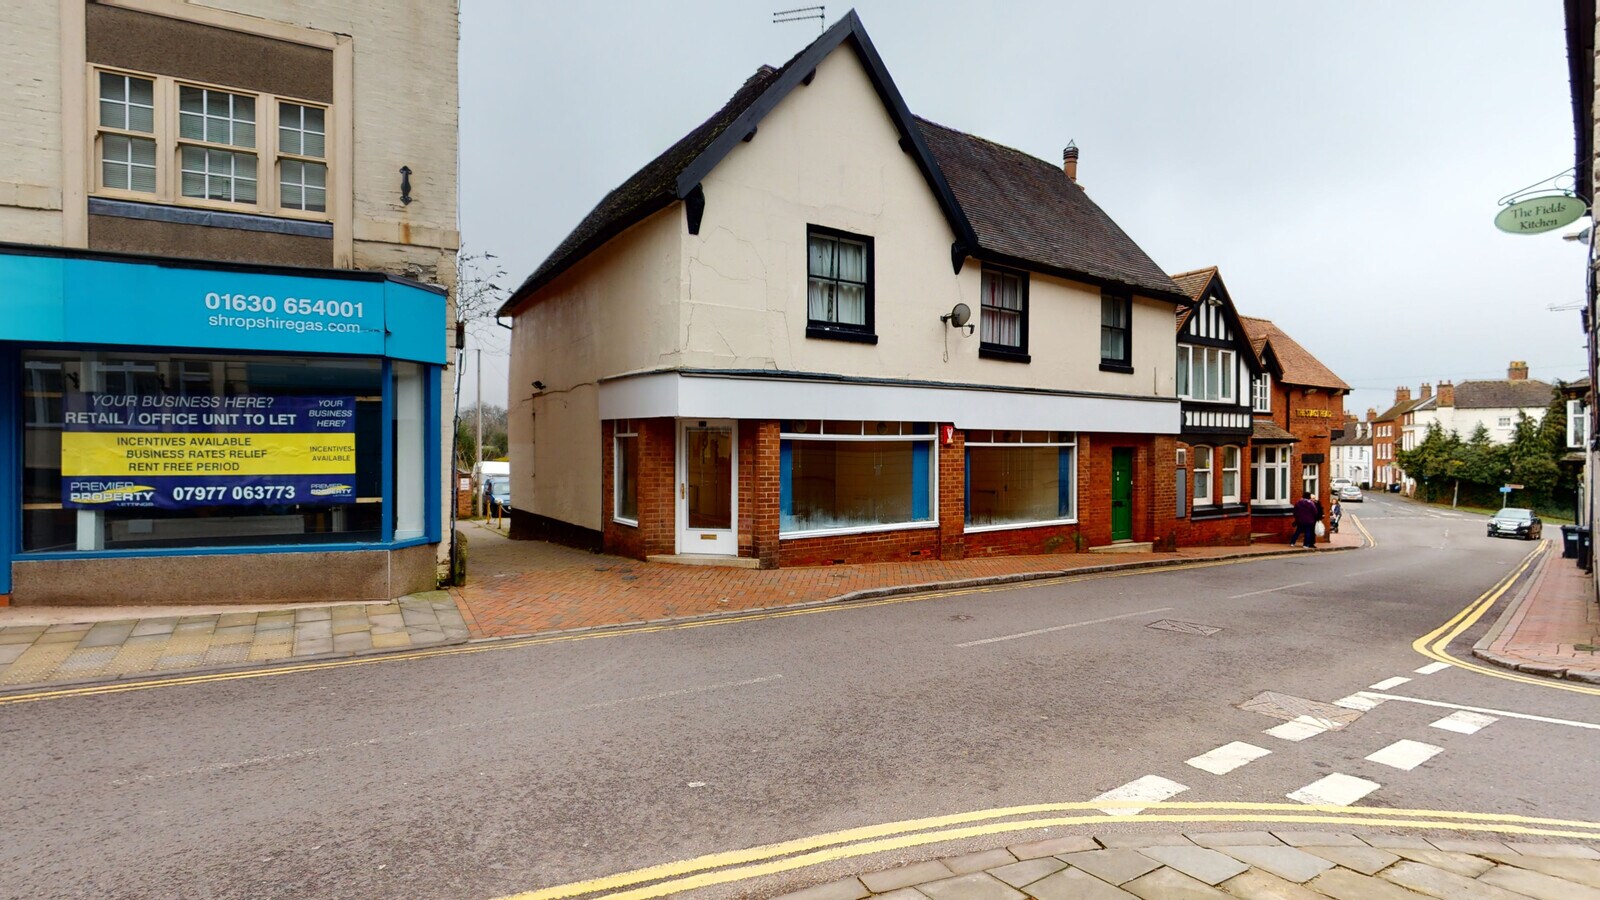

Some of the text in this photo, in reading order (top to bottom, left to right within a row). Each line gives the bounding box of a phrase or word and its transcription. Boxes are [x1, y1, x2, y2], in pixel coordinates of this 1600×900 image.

[1511, 202, 1566, 219] The Fields
[1520, 218, 1558, 230] Kitchen
[205, 292, 364, 318] 01630 654001
[208, 313, 361, 334] shropshiregas.com
[92, 395, 274, 409] YOUR BUSINESS HERE?
[319, 399, 343, 408] YOUR
[65, 412, 297, 426] RETAIL / OFFICE UNIT TO LET
[308, 409, 352, 418] BUSINESS
[316, 419, 346, 428] HERE?
[117, 437, 252, 447] INCENTIVES AVAILABLE
[126, 449, 267, 459] BUSINESS RATES RELIEF
[128, 462, 240, 472] RENT FREE PERIOD
[70, 492, 154, 502] PROPERTY
[173, 486, 296, 501] 07977 063773
